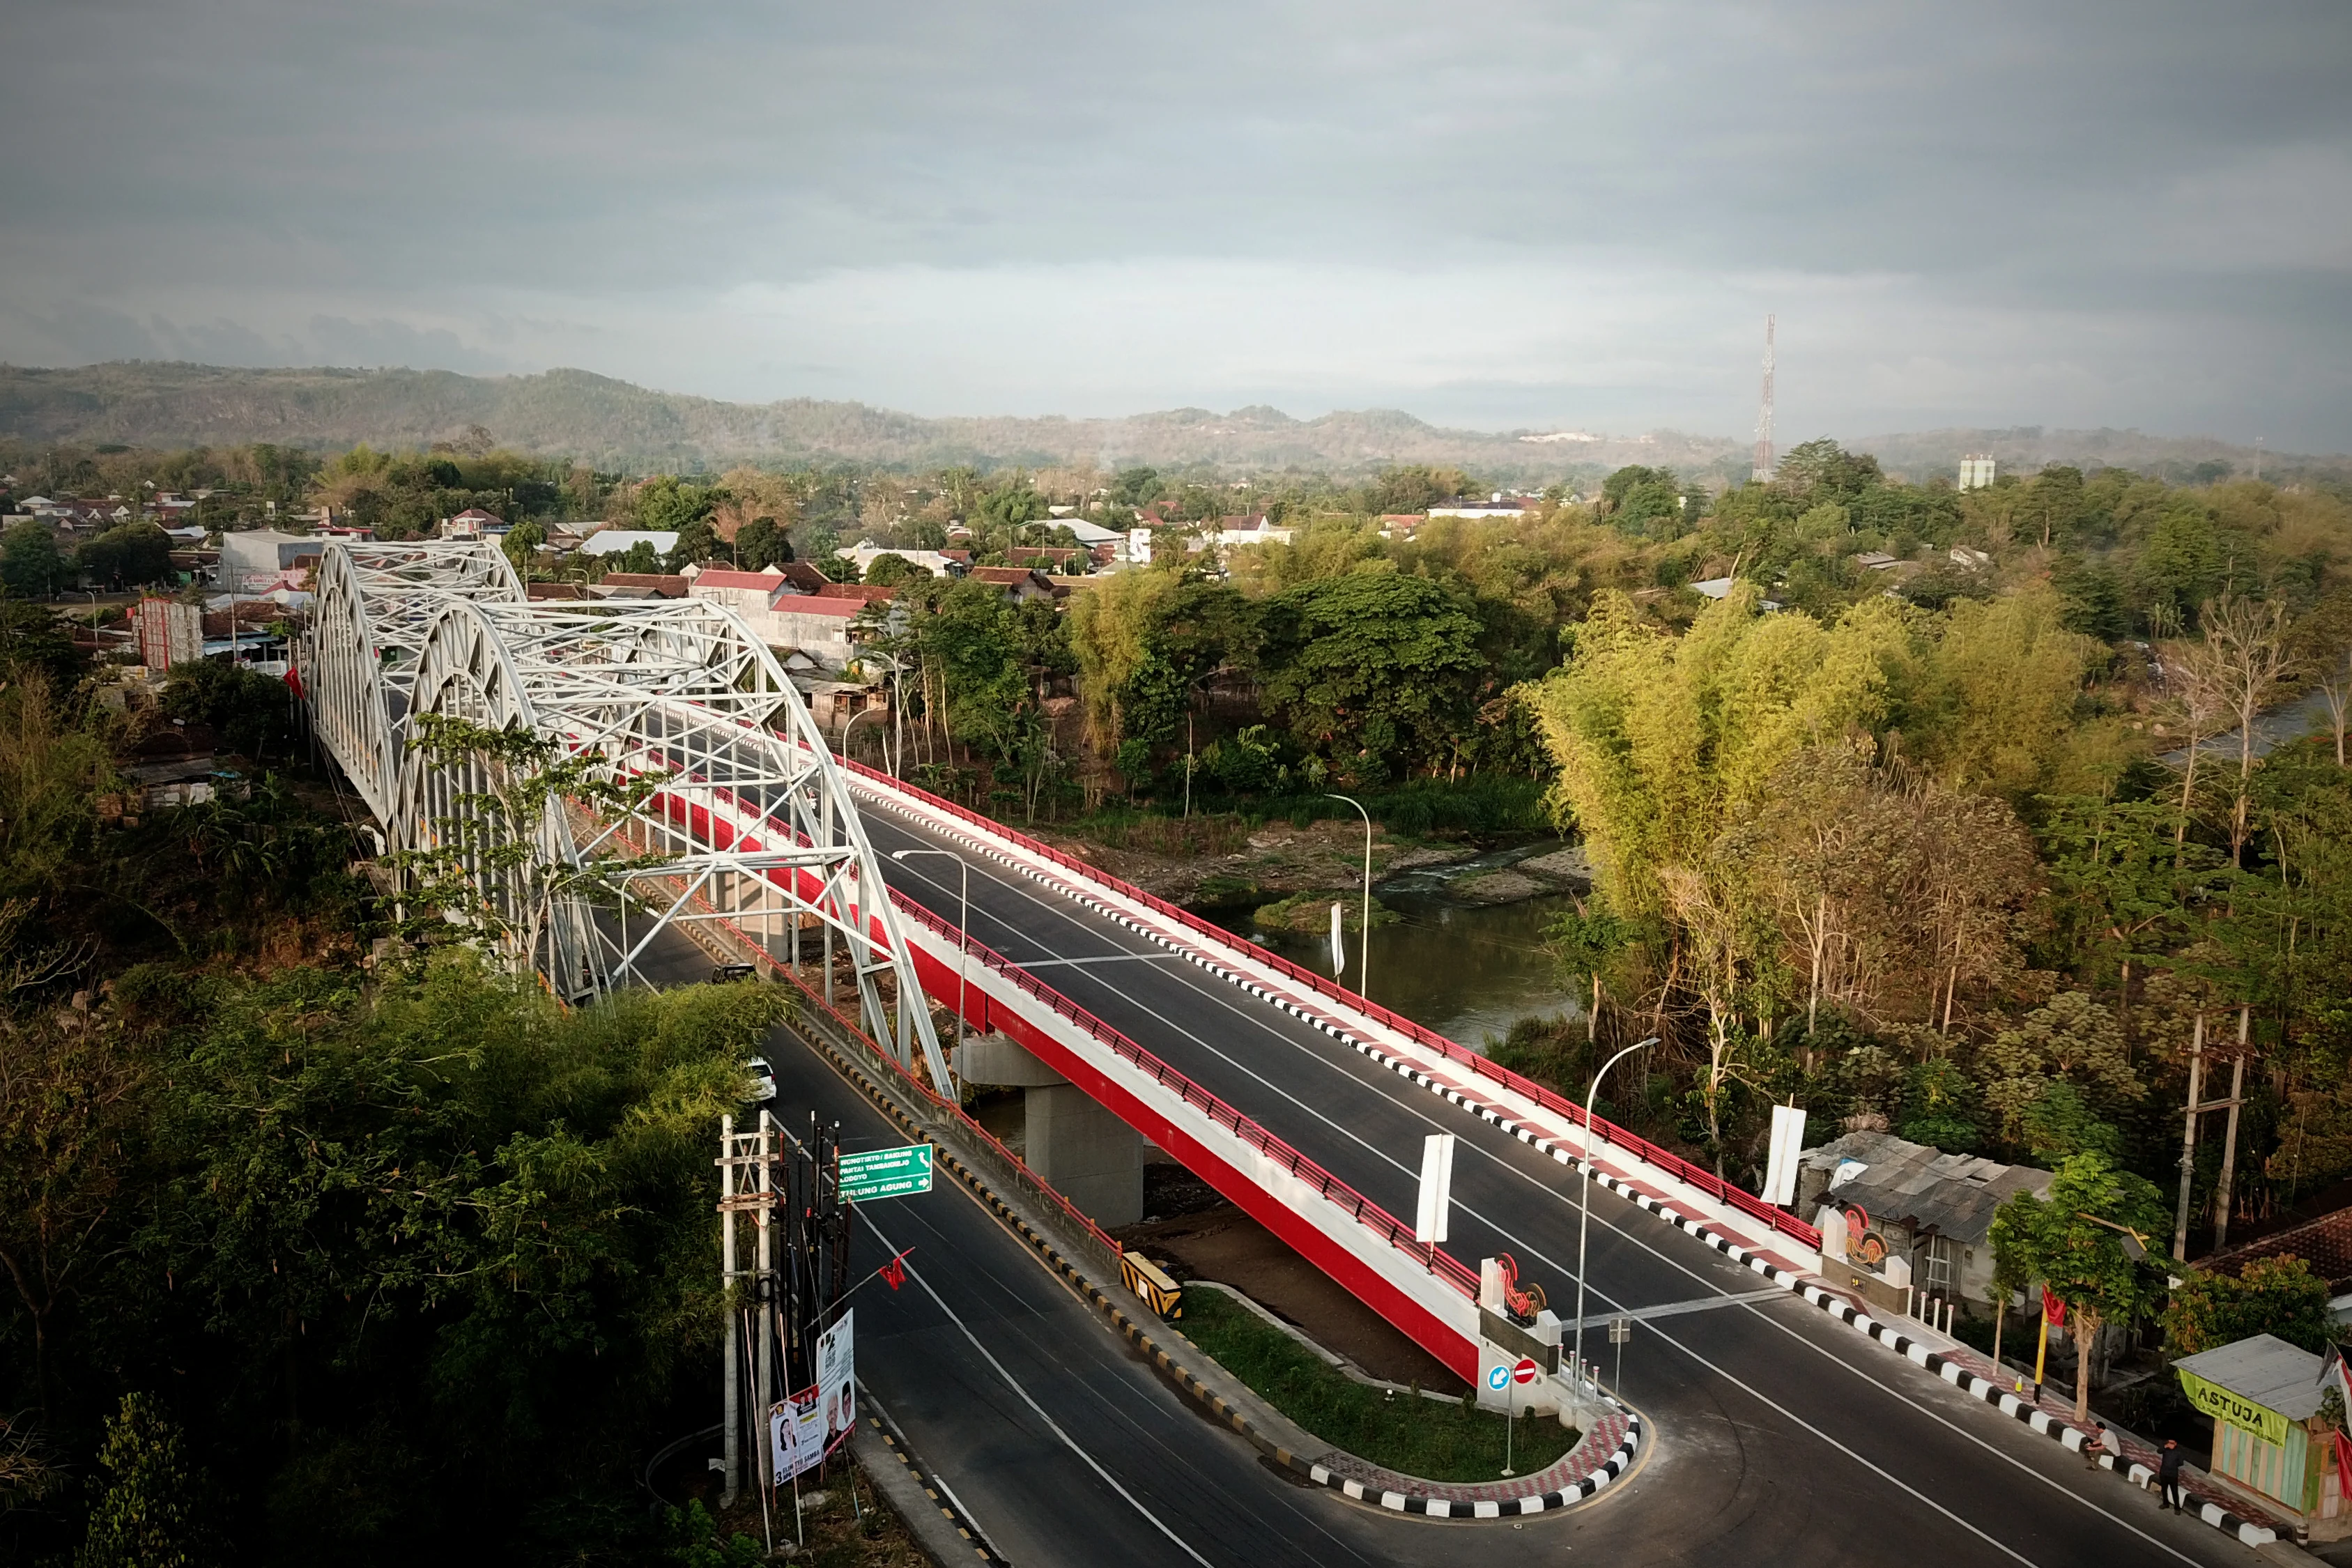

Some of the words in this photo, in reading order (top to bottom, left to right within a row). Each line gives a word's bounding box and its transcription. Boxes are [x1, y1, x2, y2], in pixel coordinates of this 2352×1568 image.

[840, 1166, 864, 1175] PANTAI
[840, 1186, 877, 1197] TULUNG
[879, 1181, 912, 1192] AGUNG
[2198, 1387, 2263, 1428] ASTUJA
[776, 1471, 782, 1484] 3
